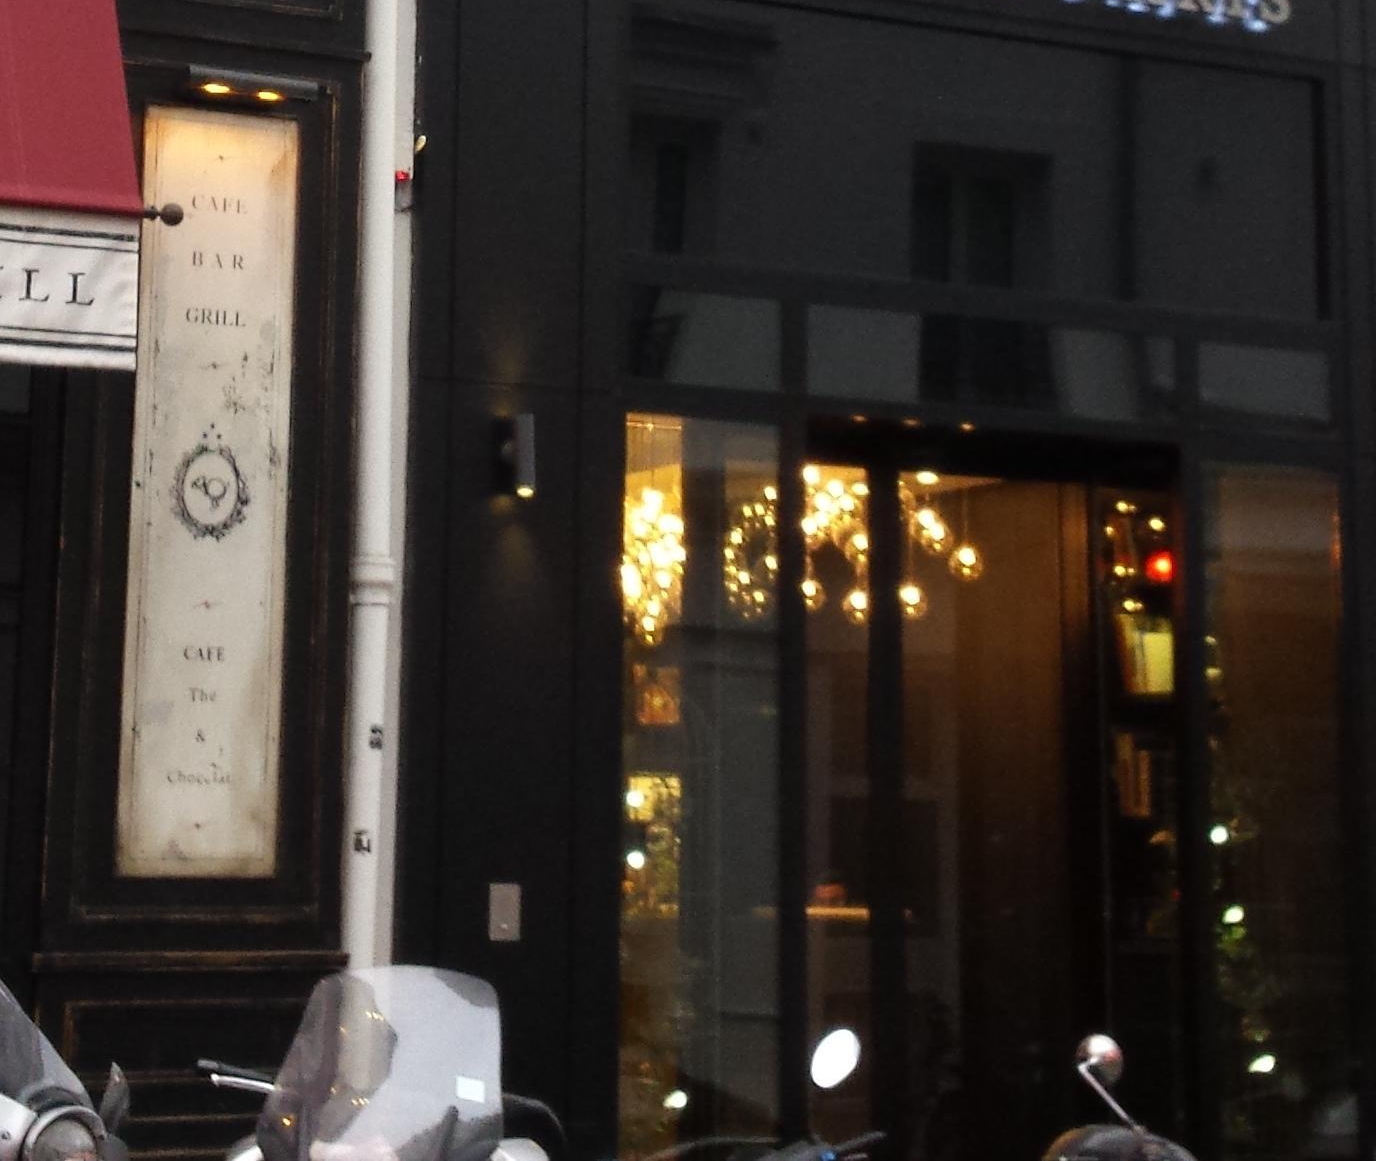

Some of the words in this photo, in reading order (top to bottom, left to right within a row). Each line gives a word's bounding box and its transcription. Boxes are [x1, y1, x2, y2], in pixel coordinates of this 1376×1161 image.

[191, 195, 249, 215] CAFE
[191, 250, 245, 270] BAR
[185, 307, 247, 328] GRILL
